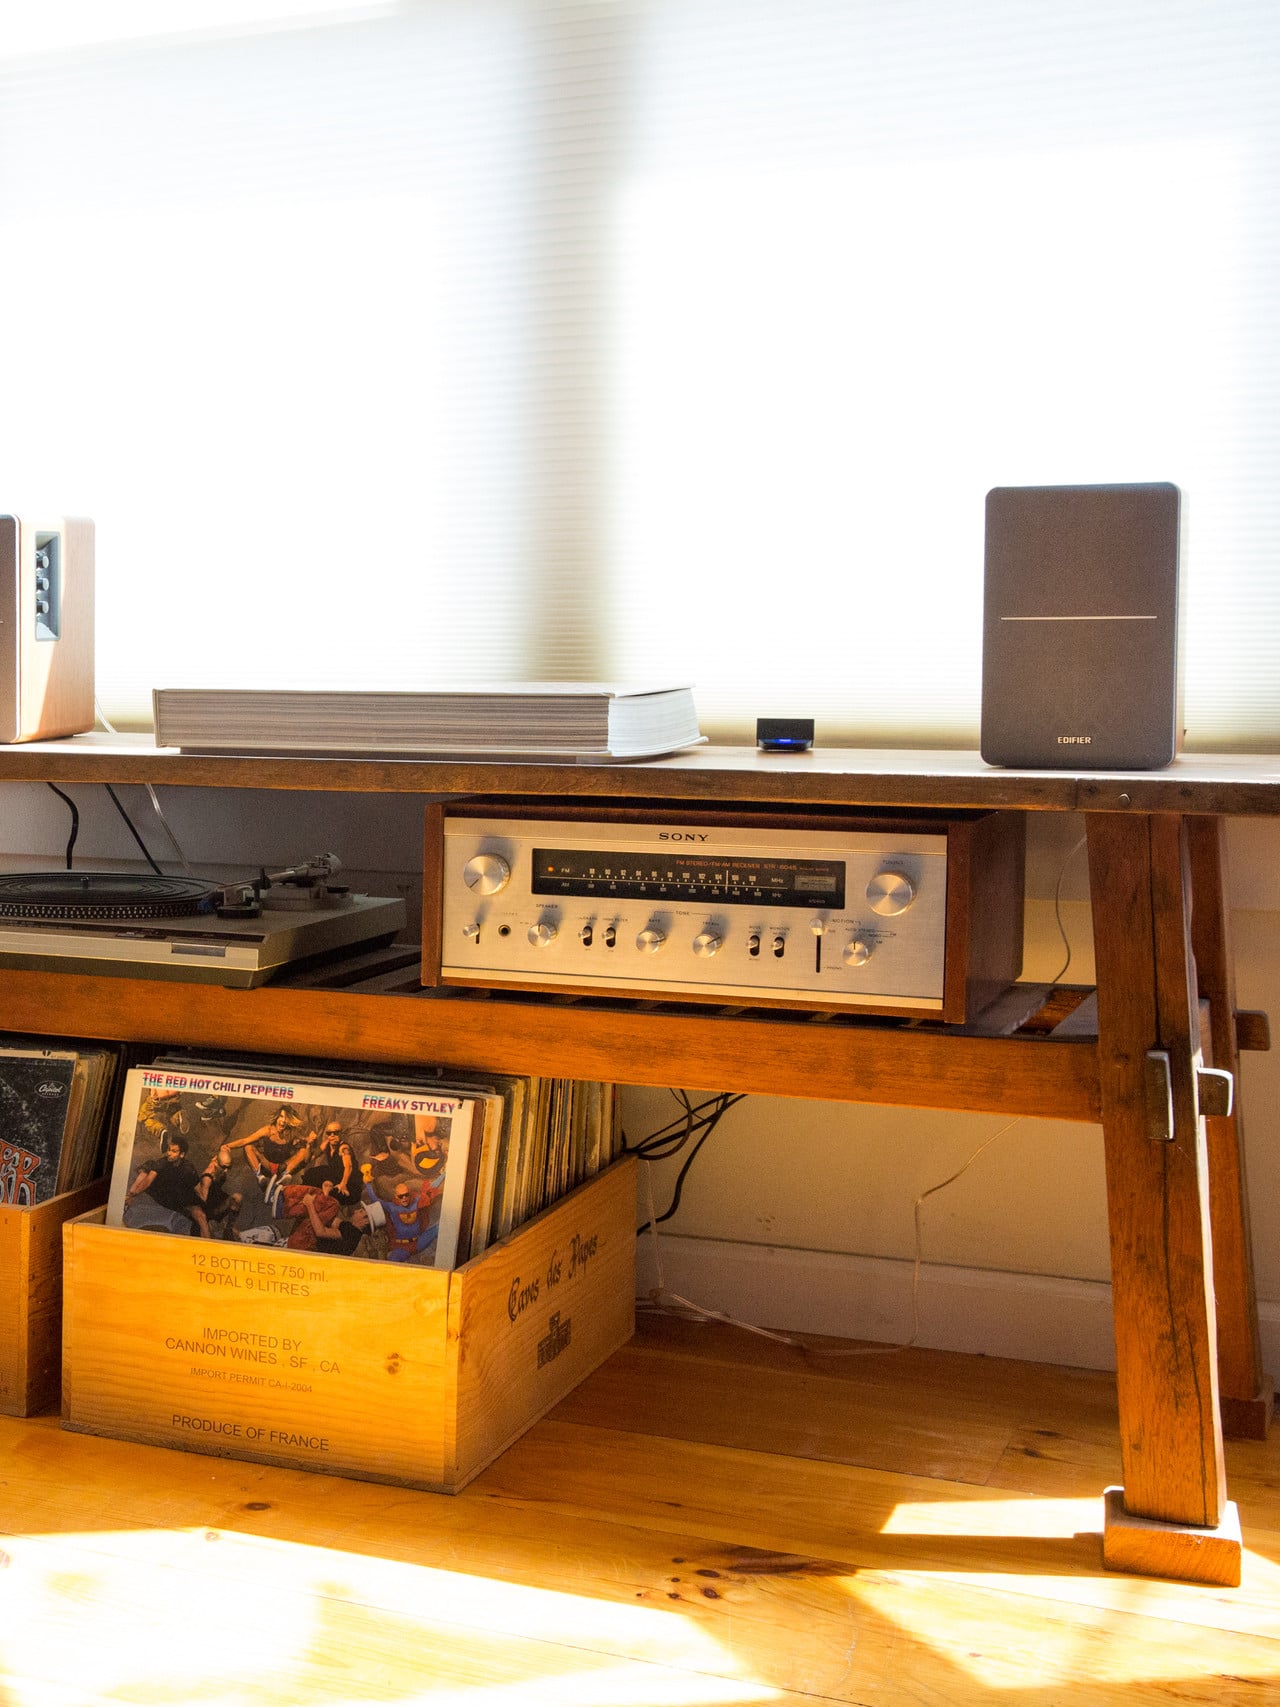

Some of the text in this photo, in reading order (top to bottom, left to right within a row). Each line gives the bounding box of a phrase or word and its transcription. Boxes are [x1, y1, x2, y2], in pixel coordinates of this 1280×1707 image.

[1057, 736, 1092, 744] EDIFIER
[658, 832, 709, 842] SONY
[142, 1072, 295, 1100] THE RED HOT CHILI PEPPERS
[362, 1094, 455, 1114] FREAKY STYLEY
[191, 1253, 207, 1266] 12
[209, 1255, 276, 1275] BOTTLES
[281, 1264, 305, 1280] 750
[196, 1270, 310, 1297] TOTAL 9 LITRES
[202, 1327, 302, 1352] IMPORTED BY
[164, 1337, 227, 1358] CANNON
[230, 1346, 278, 1365] WINES
[319, 1359, 341, 1374] CA
[190, 1367, 227, 1381] IMPORT
[228, 1372, 266, 1386] PERMIT
[171, 1413, 330, 1452] PRODUCE OF FRANCE
